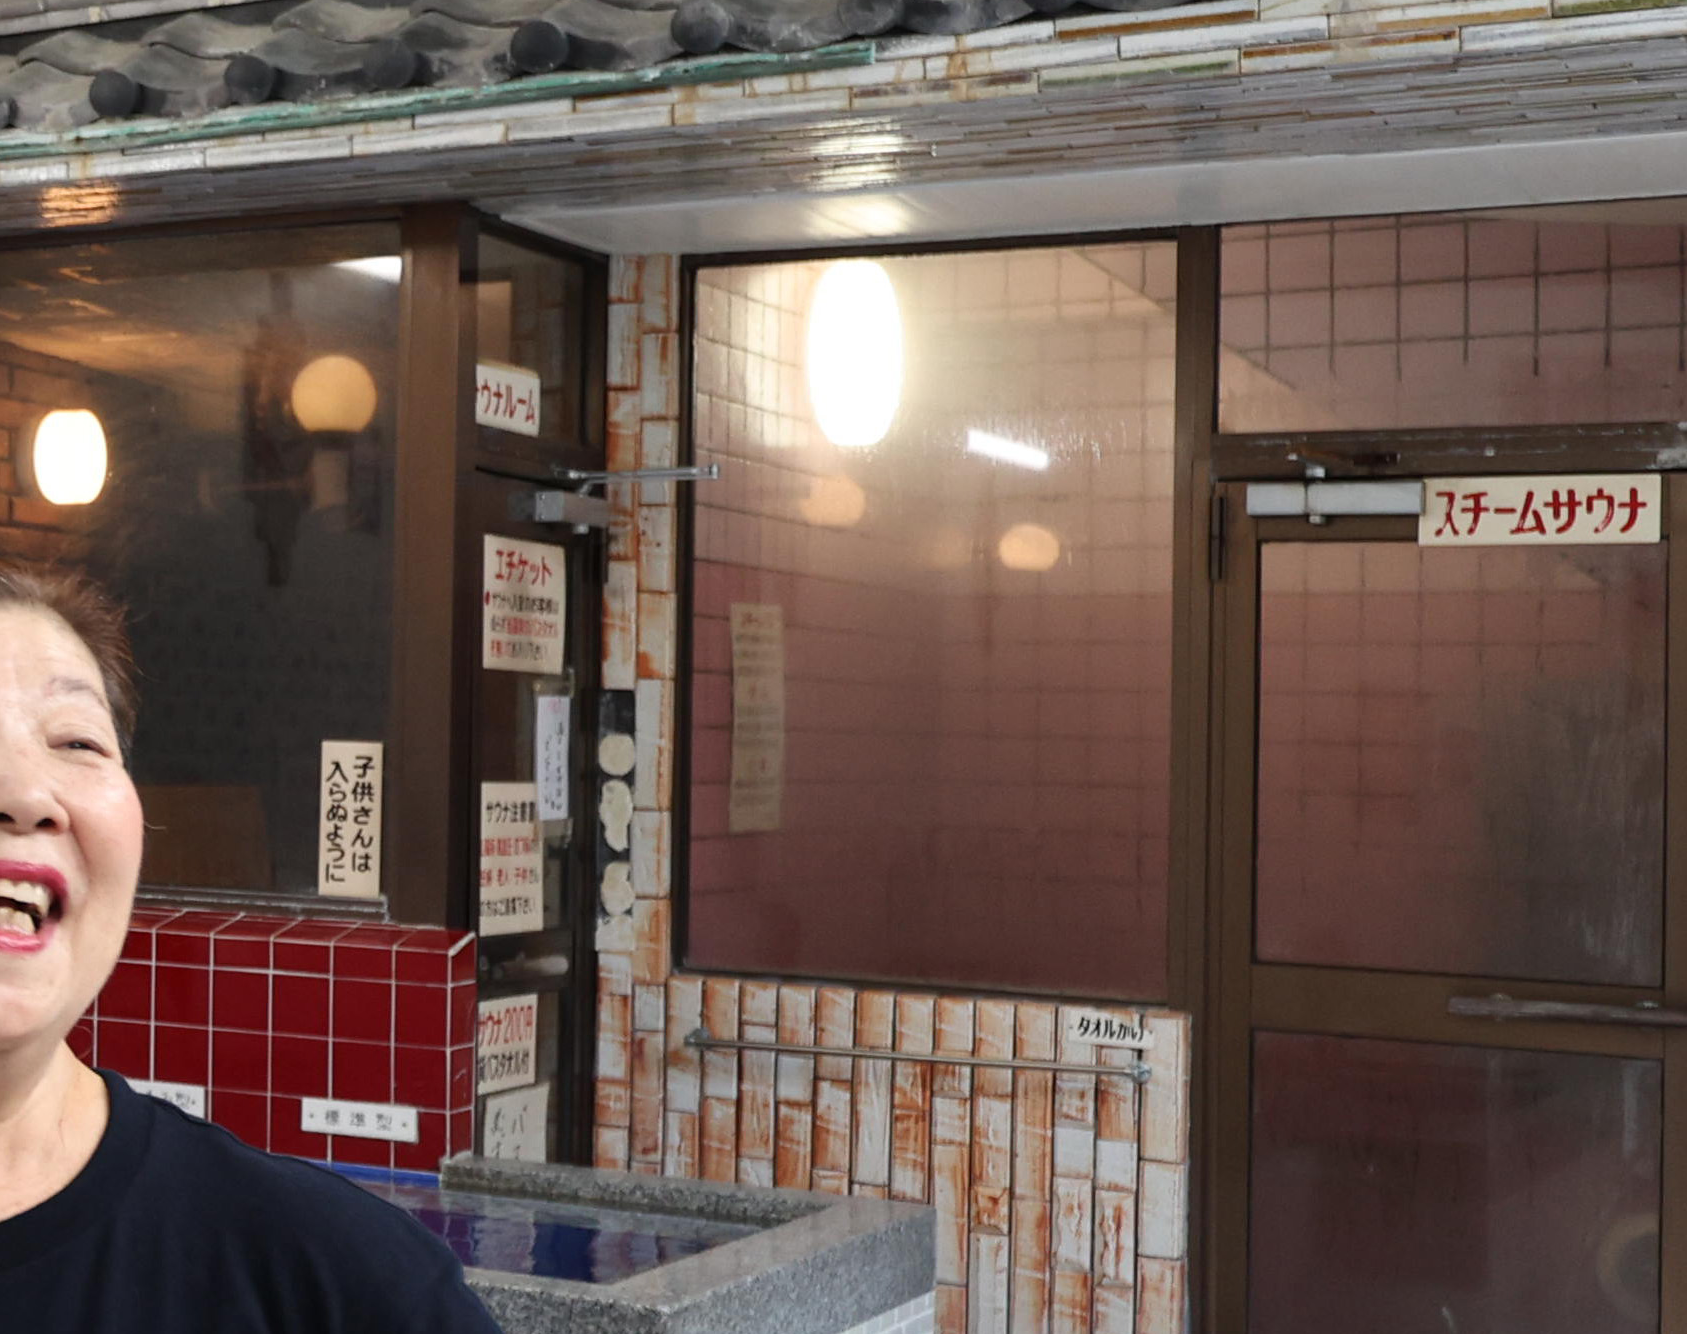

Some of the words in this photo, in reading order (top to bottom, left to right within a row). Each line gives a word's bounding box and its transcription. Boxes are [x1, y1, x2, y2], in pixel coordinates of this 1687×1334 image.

[475, 378, 536, 426] ウナルーム
[1433, 487, 1649, 537] スチームサウナ
[494, 549, 553, 587] エチケット
[325, 760, 349, 884] 入らぬように
[351, 754, 375, 873] 子供さんは
